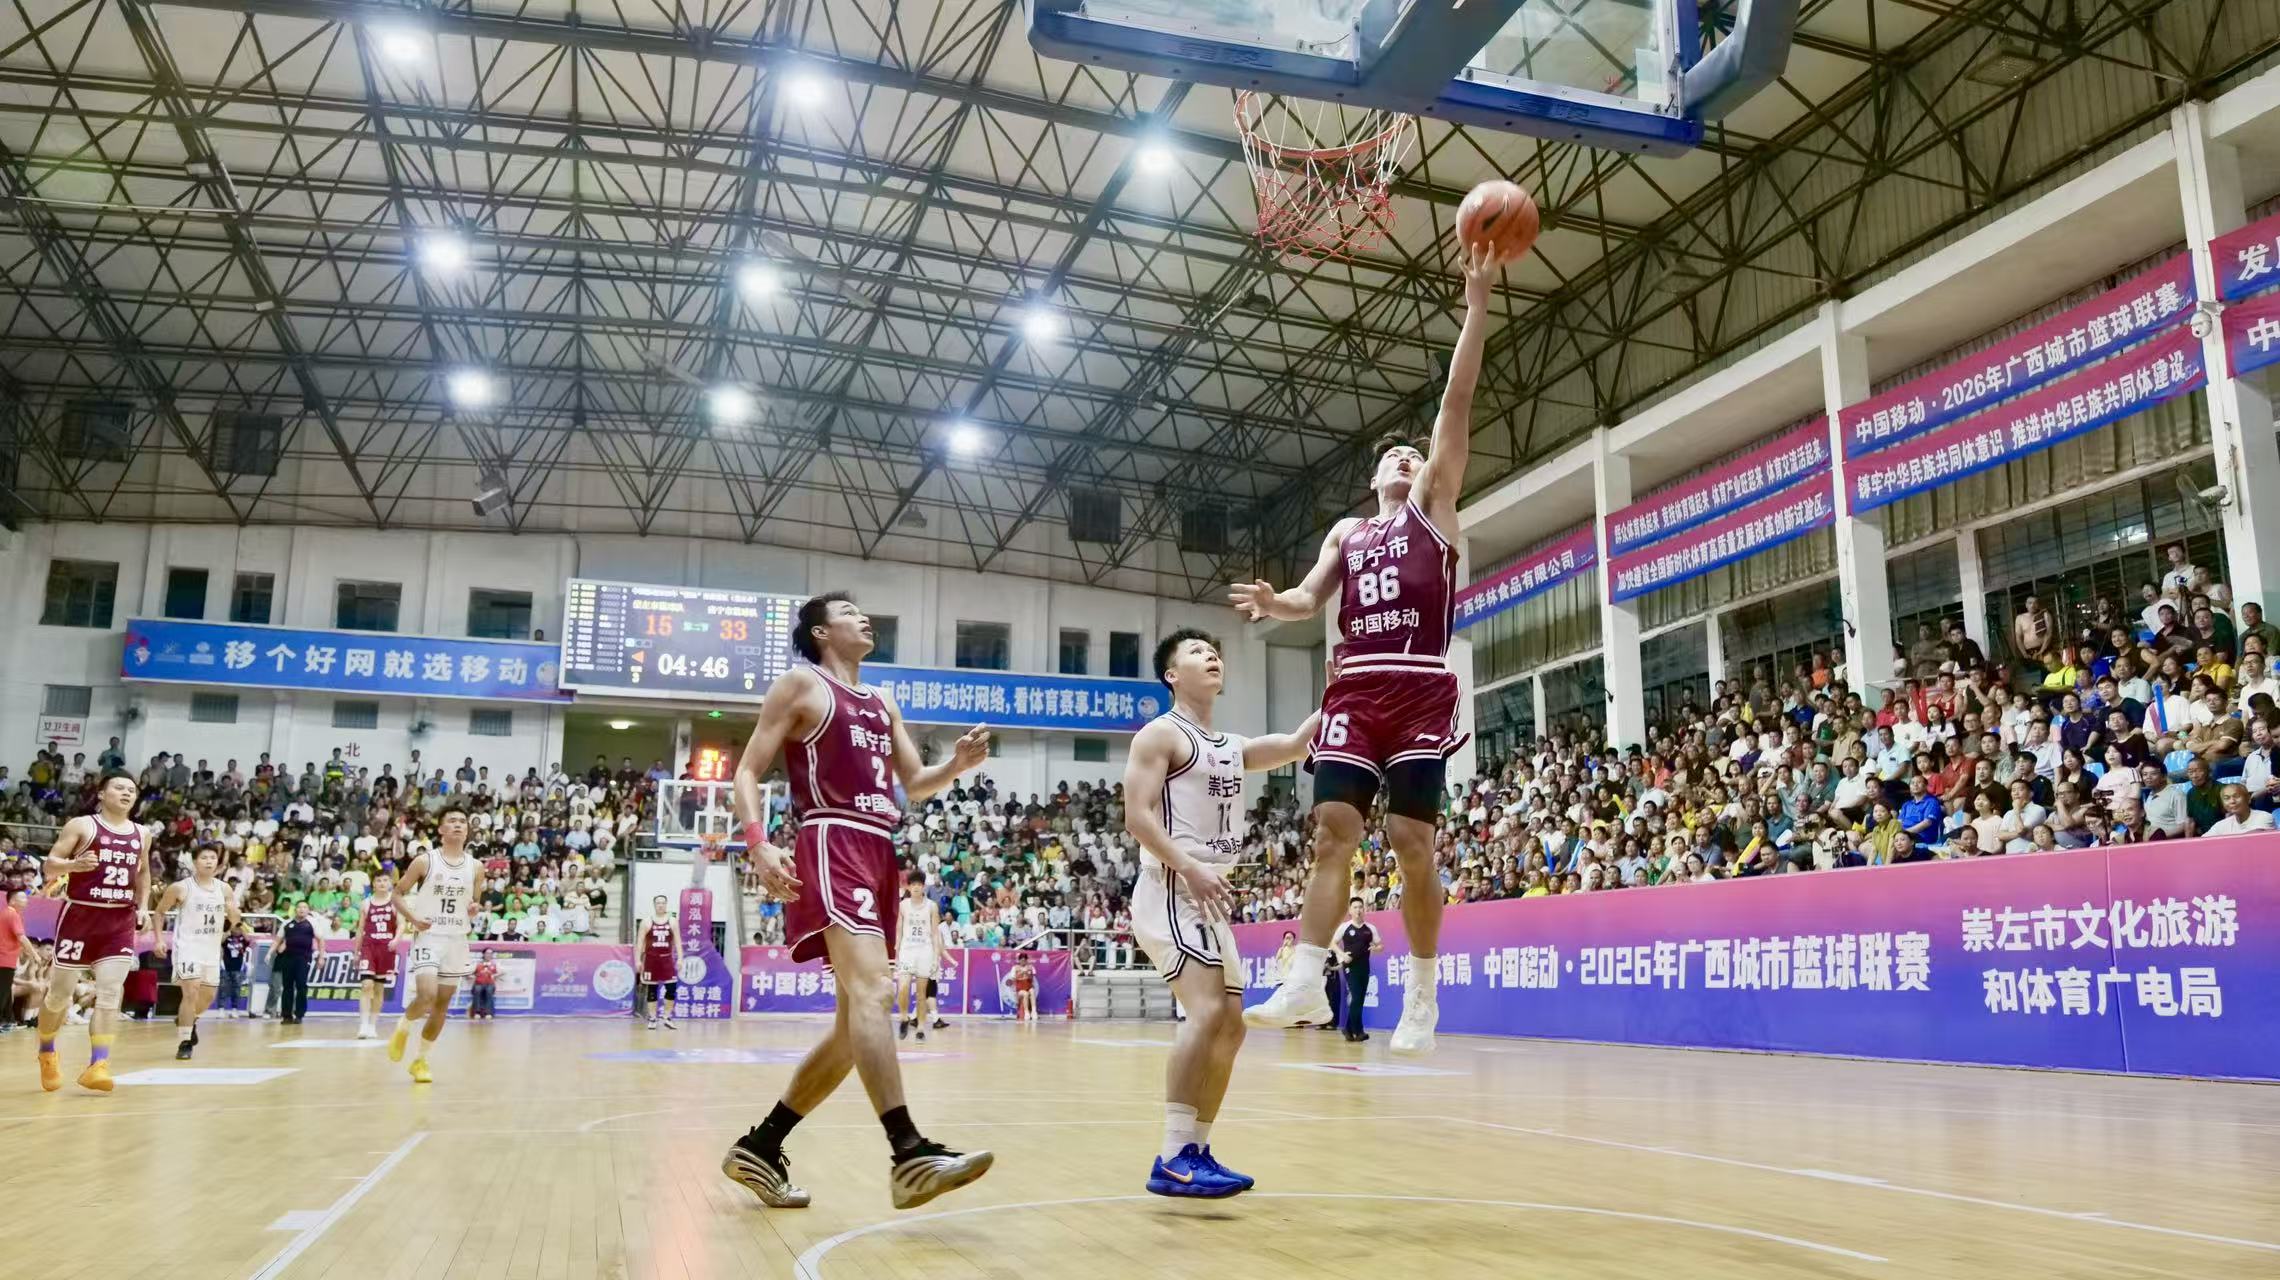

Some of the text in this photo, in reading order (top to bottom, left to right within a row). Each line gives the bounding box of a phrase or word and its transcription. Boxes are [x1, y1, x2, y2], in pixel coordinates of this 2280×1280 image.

[2238, 236, 2280, 281] 发
[2247, 317, 2280, 352] 中
[1856, 281, 2179, 443] 中国移动·2026年广西城市篮球联赛
[1857, 350, 2187, 499] 铸牢中华民族共同体意识 推进中华民族共同体建设
[1346, 536, 1409, 573] 南宁市
[1617, 492, 1824, 591] 加快建设全国新时代体育高质量发展改革创新试验区
[1358, 565, 1401, 607] 86
[645, 614, 672, 637] 15
[720, 619, 748, 641] 33
[1350, 607, 1420, 636] 中国移动
[224, 640, 527, 685] 移个好网就选移动
[658, 653, 729, 678] 04:46
[849, 724, 892, 756] 南宁市
[871, 755, 888, 790] 2
[99, 848, 138, 865] 南宁市
[103, 866, 129, 886] 23
[203, 914, 216, 925] 14
[440, 898, 456, 914] 15
[853, 887, 878, 921] 2
[911, 926, 923, 936] 26
[1962, 894, 2240, 953] 崇左市文化旅游
[57, 939, 85, 960] 23
[415, 947, 431, 961] 15
[1484, 932, 1931, 991] 中国移动·2026年广西城市篮球联赛
[182, 962, 194, 974] 14
[752, 971, 836, 996] 中国移动
[1387, 952, 1472, 986] 自治育局
[1982, 965, 2223, 1018] 和体育广电局
